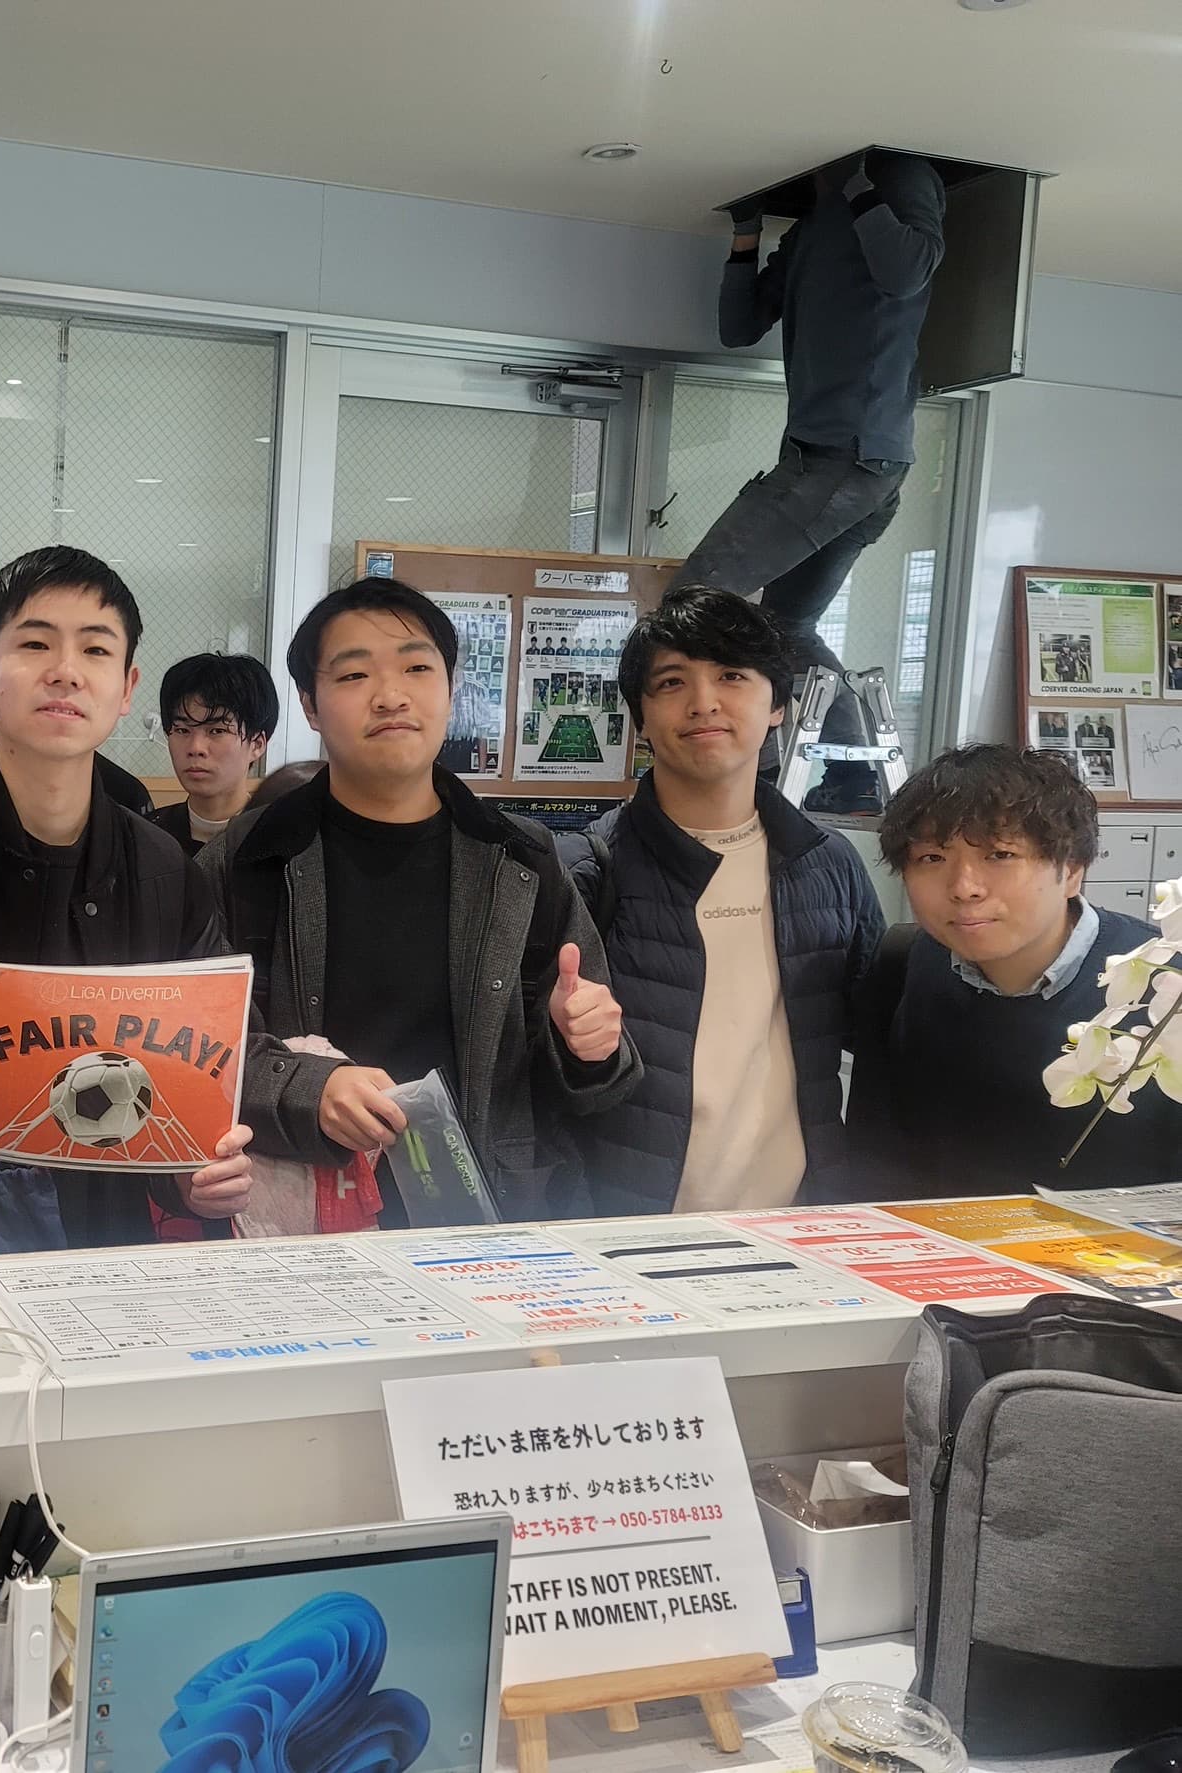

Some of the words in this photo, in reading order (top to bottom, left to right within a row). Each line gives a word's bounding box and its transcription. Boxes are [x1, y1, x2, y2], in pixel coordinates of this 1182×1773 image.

[703, 907, 746, 919] adidas
[113, 1014, 233, 1079] PLAY!
[188, 1338, 378, 1361] コート利用料金表
[438, 1416, 705, 1461] ただいま席を外しております
[455, 1471, 714, 1511] 恐れ入りますが、少々おまちください
[620, 1504, 723, 1529] 050-5784-8133
[567, 1576, 588, 1598] IS
[591, 1572, 630, 1595] NOT
[635, 1563, 720, 1590] PRESENT.
[555, 1610, 570, 1631] A
[572, 1599, 668, 1629] MOMENT,
[668, 1591, 737, 1617] PLEASE.
